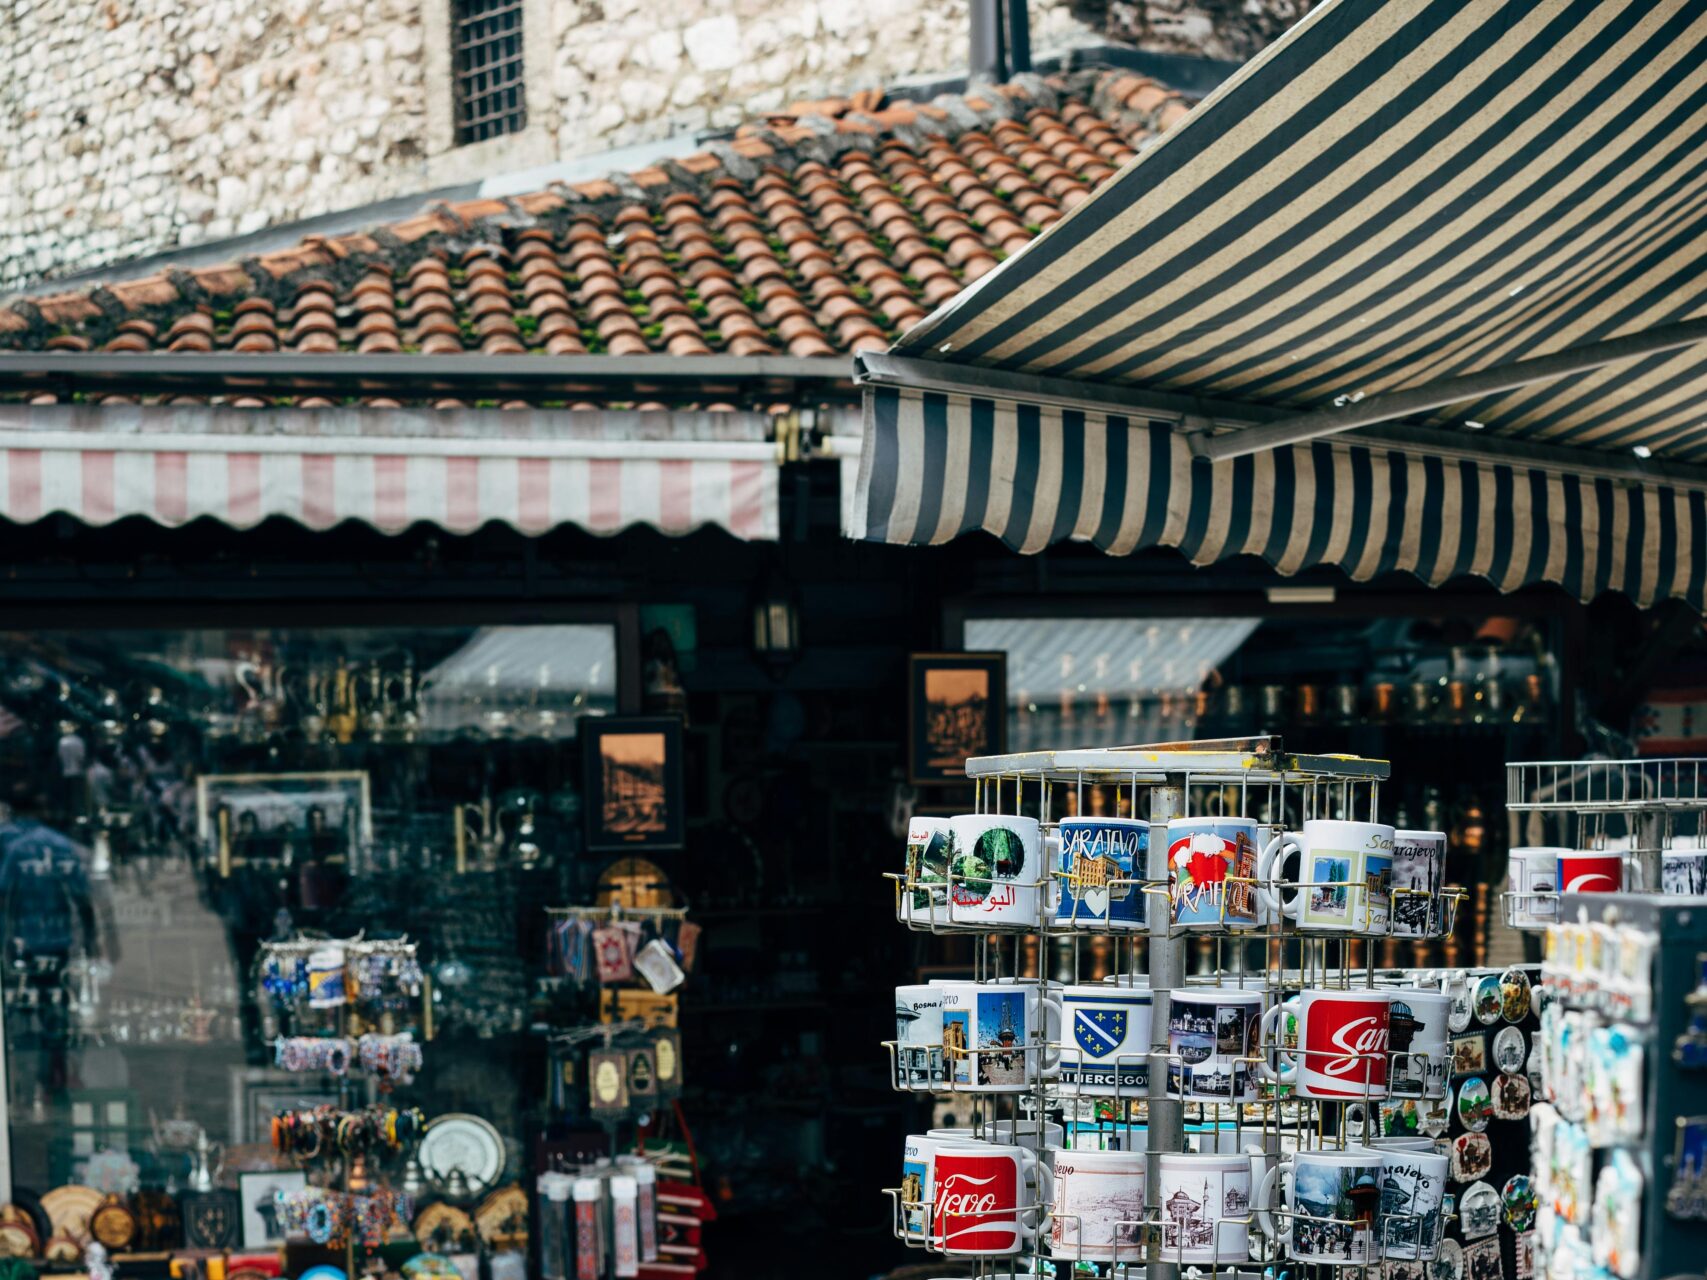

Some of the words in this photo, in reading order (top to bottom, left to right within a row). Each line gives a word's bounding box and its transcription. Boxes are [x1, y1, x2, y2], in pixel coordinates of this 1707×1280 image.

[1063, 829, 1138, 860] SARAJEVO
[913, 1001, 937, 1011] Bosna
[934, 1176, 997, 1218] jevo
